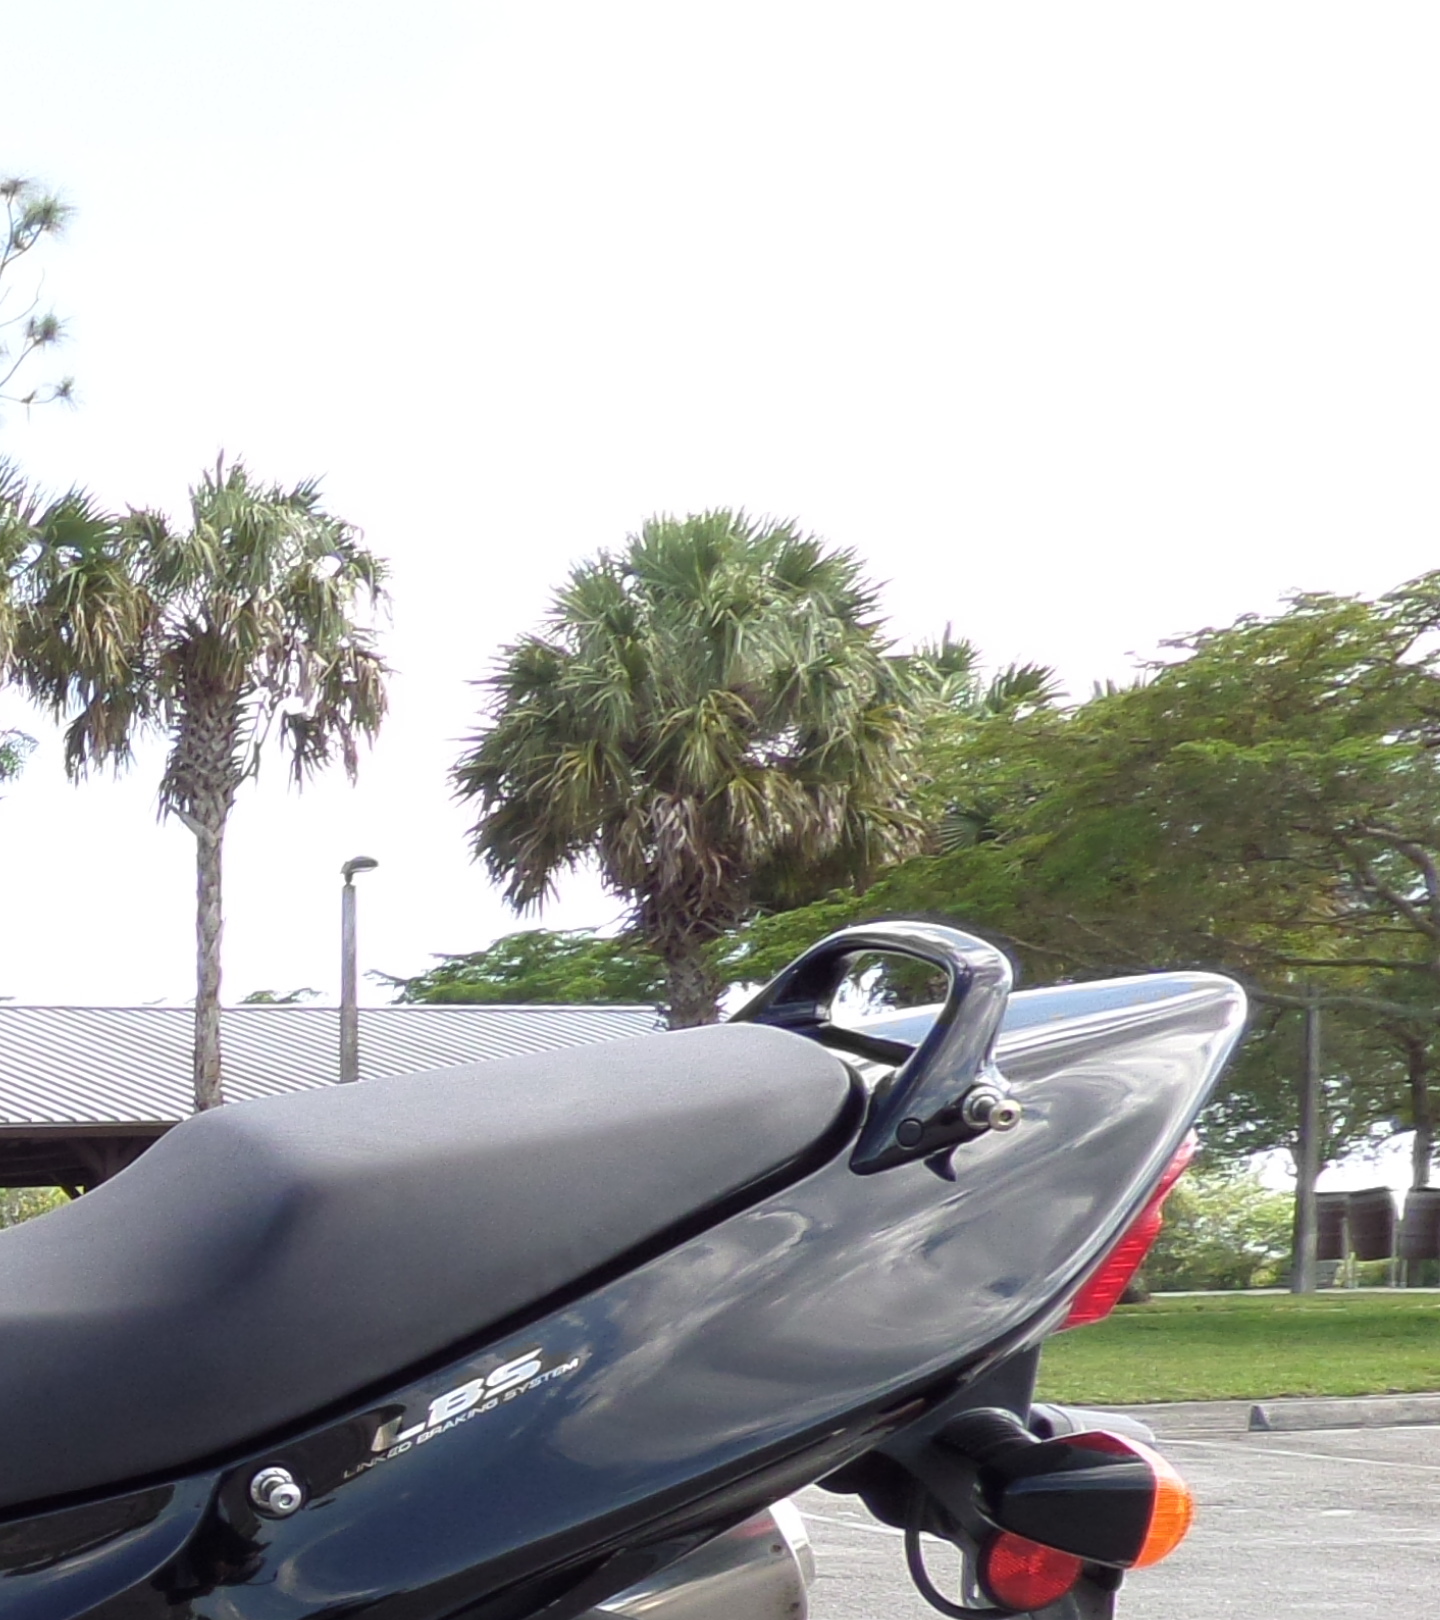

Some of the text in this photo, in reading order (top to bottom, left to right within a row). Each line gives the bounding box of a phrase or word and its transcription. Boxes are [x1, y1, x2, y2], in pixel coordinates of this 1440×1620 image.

[343, 1358, 579, 1478] LINKED BRAKING SYSTEM
[371, 1348, 542, 1452] LBS
